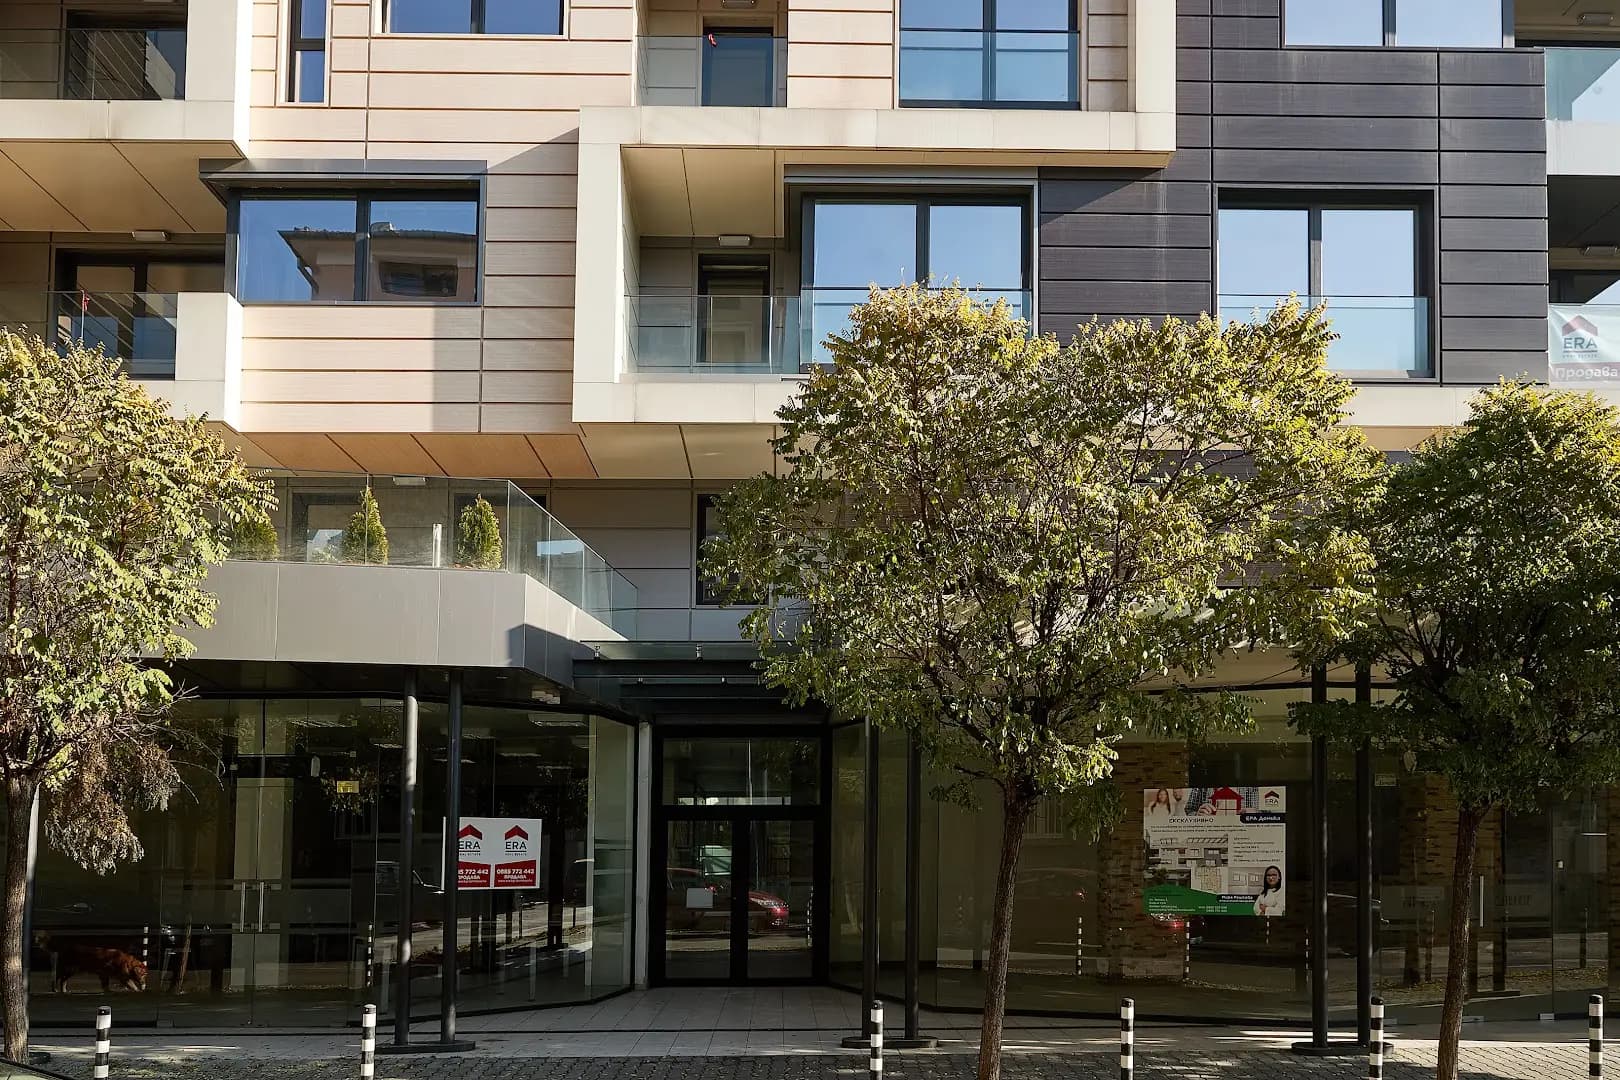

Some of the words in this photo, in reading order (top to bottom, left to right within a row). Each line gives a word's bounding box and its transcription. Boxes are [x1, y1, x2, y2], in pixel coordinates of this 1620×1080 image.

[1564, 337, 1597, 349] ERA
[1557, 366, 1618, 380] Продава
[459, 841, 481, 850] ERA
[505, 842, 527, 850] ERA
